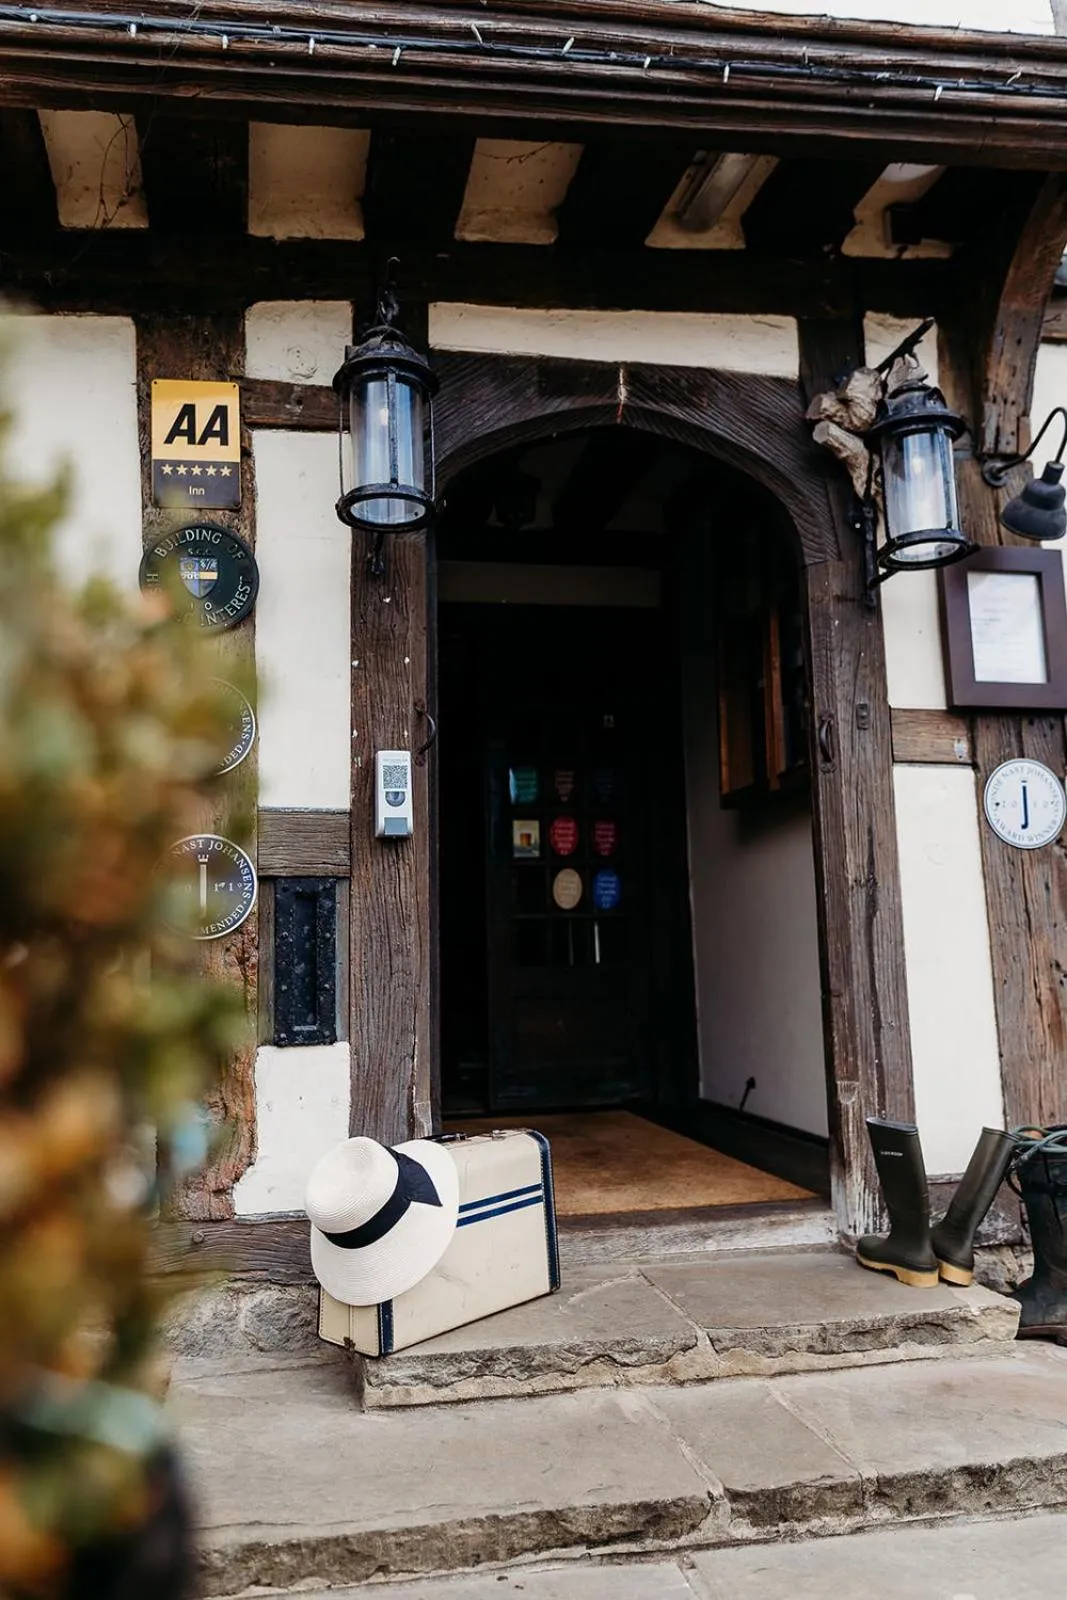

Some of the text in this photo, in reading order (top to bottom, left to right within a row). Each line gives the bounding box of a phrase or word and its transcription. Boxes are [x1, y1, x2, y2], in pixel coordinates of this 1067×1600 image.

[164, 403, 229, 446] AA
[189, 485, 205, 496] Inn
[154, 529, 222, 557] BUILDING
[200, 575, 254, 626] INTEREST
[208, 839, 253, 900] JOHANSENS
